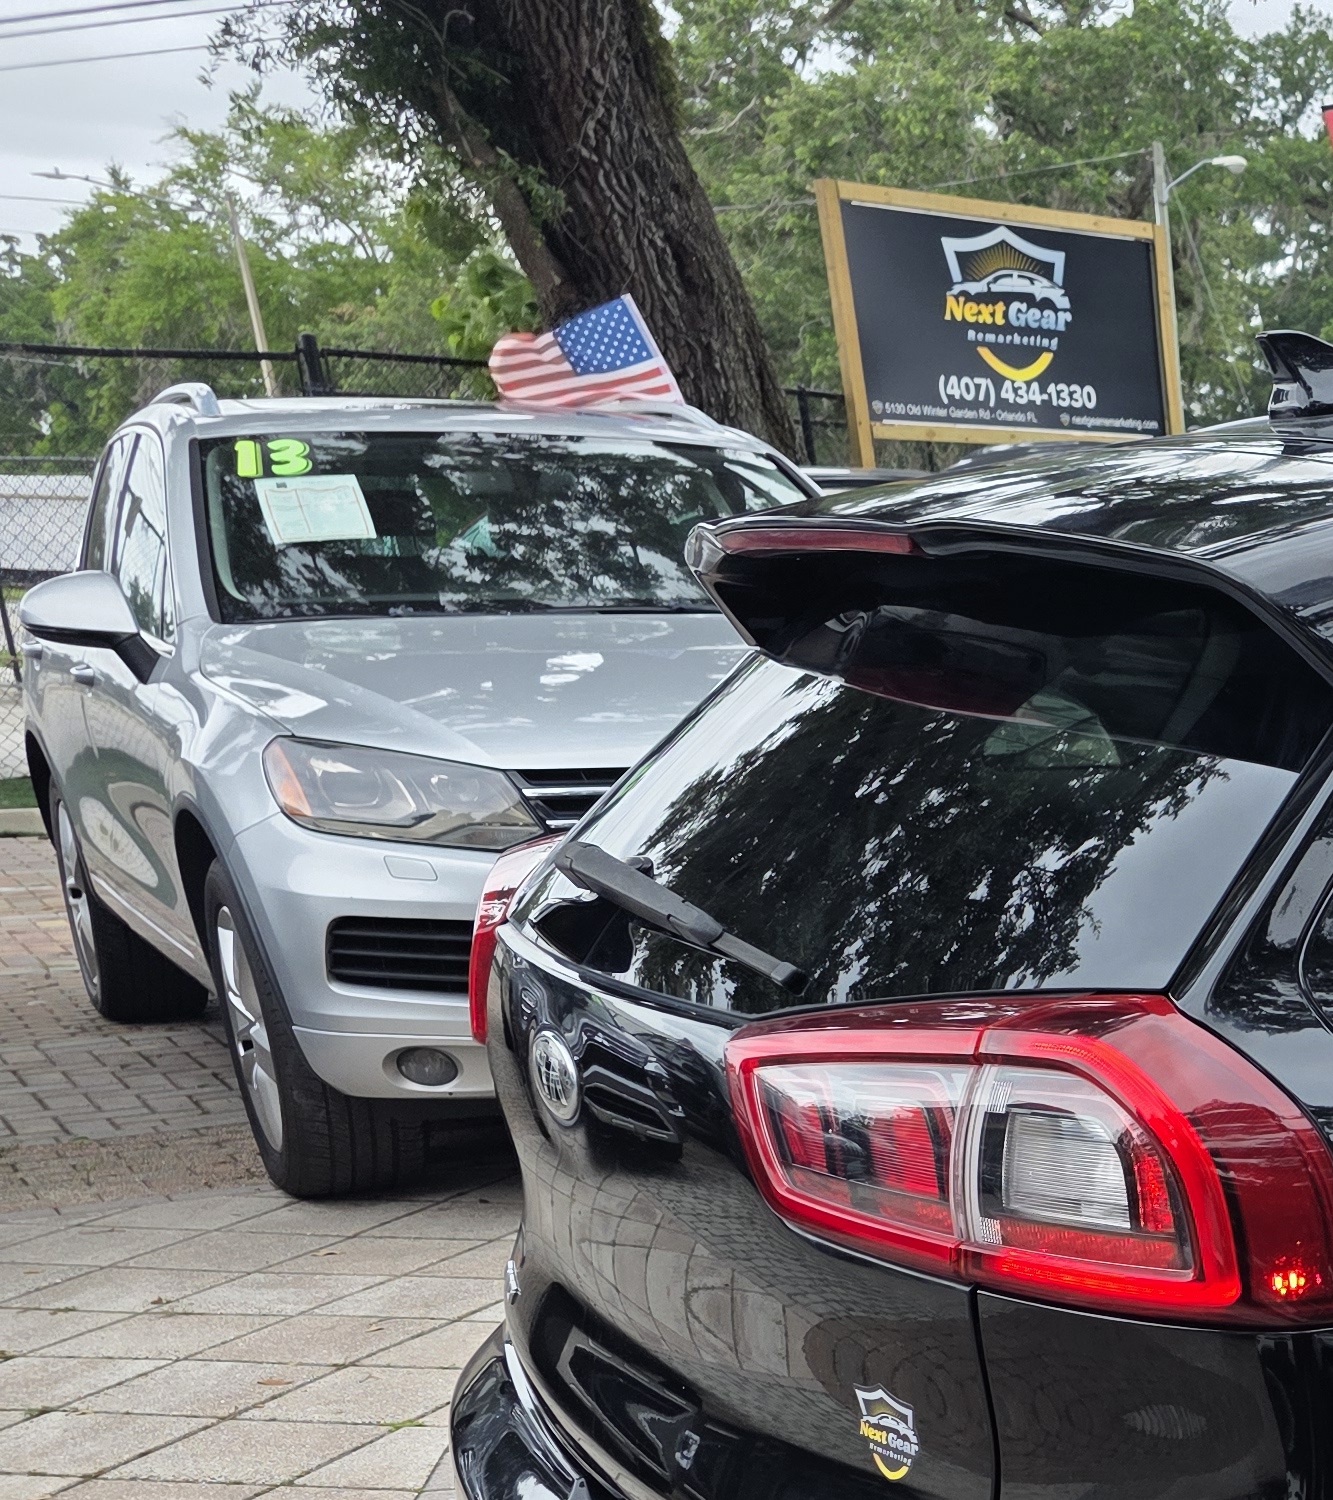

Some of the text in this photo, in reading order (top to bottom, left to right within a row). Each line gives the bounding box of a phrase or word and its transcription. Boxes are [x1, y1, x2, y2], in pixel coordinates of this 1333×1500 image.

[944, 295, 1073, 331] Next Gear
[967, 329, 1059, 351] Remarketing
[906, 403, 921, 415] Old
[938, 374, 1097, 409] (407) 434-1330
[234, 438, 313, 478] 13
[860, 1419, 919, 1456] Next Gear
